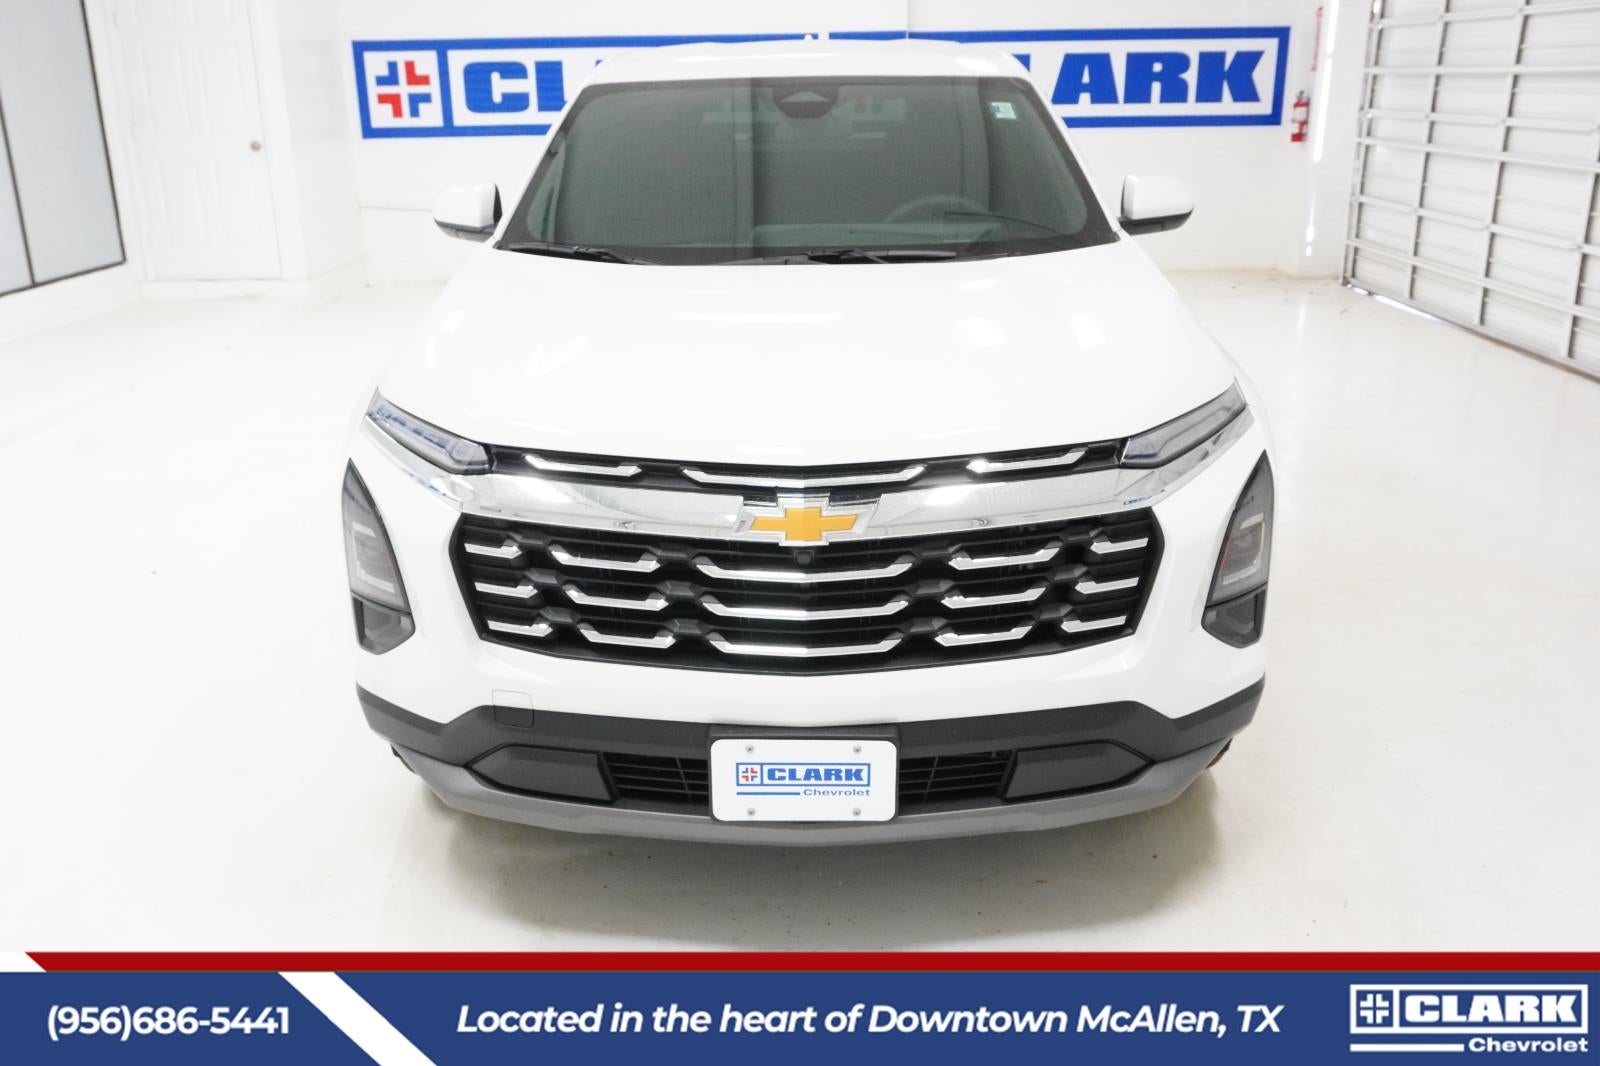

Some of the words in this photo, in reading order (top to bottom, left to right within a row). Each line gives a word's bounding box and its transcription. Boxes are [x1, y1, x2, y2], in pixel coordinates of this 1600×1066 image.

[463, 60, 603, 113] CL
[1012, 51, 1265, 105] ARK
[767, 768, 864, 781] CLARK
[803, 788, 870, 797] Chevrolet
